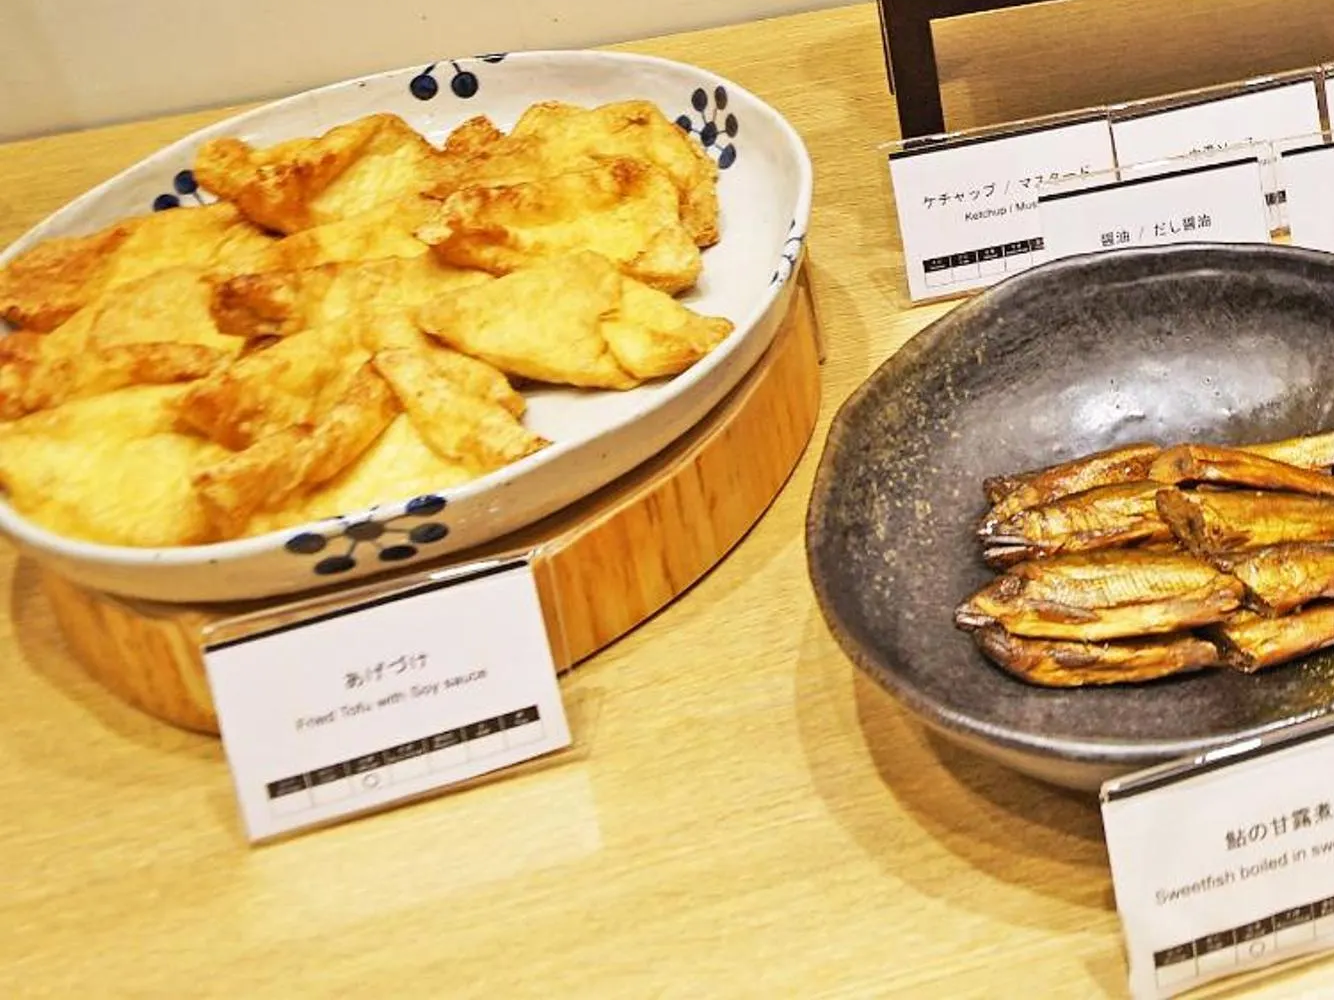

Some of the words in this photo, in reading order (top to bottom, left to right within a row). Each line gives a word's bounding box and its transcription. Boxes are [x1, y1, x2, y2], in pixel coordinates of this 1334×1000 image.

[924, 182, 997, 209] ケチャップ
[965, 206, 1008, 222] Ketchup
[343, 652, 429, 690] あげづけ
[296, 710, 335, 732] Fried
[1226, 801, 1334, 850] 鮎の甘露煮
[1155, 870, 1236, 906] Sweetfish
[1240, 853, 1289, 881] boiled
[1292, 846, 1308, 866] in
